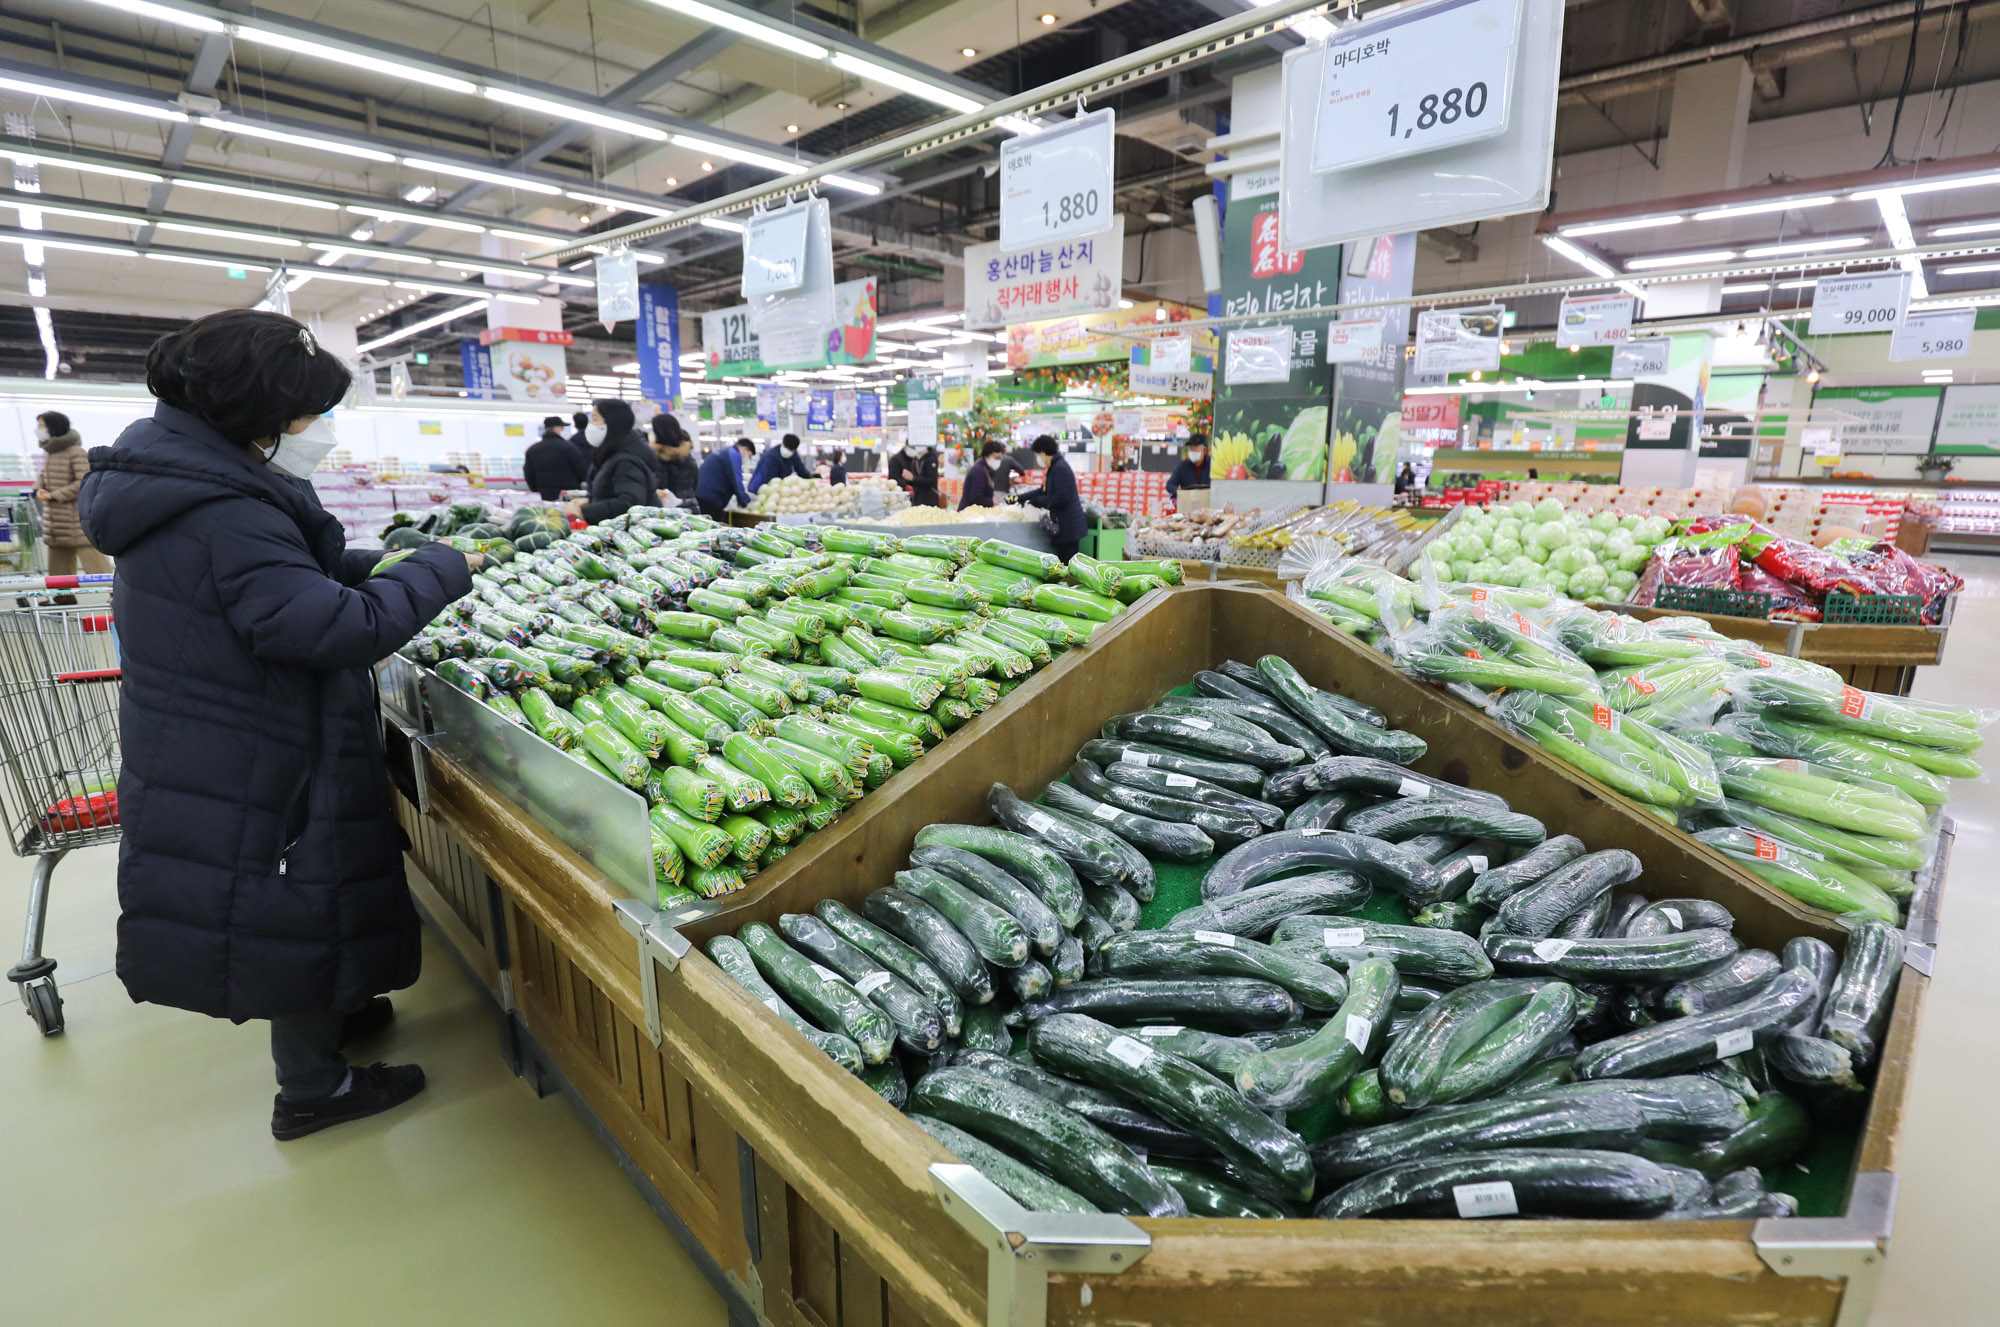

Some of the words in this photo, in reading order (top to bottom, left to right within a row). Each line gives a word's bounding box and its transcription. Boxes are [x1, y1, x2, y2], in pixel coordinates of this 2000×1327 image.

[1334, 38, 1391, 68] 마디호박
[1387, 82, 1488, 139] 1,880
[1008, 153, 1032, 171] 애호박
[1042, 189, 1099, 228] 1,880
[1844, 308, 1896, 325] 99,000
[1594, 328, 1627, 342] 1,480
[1922, 339, 1963, 354] 5,980
